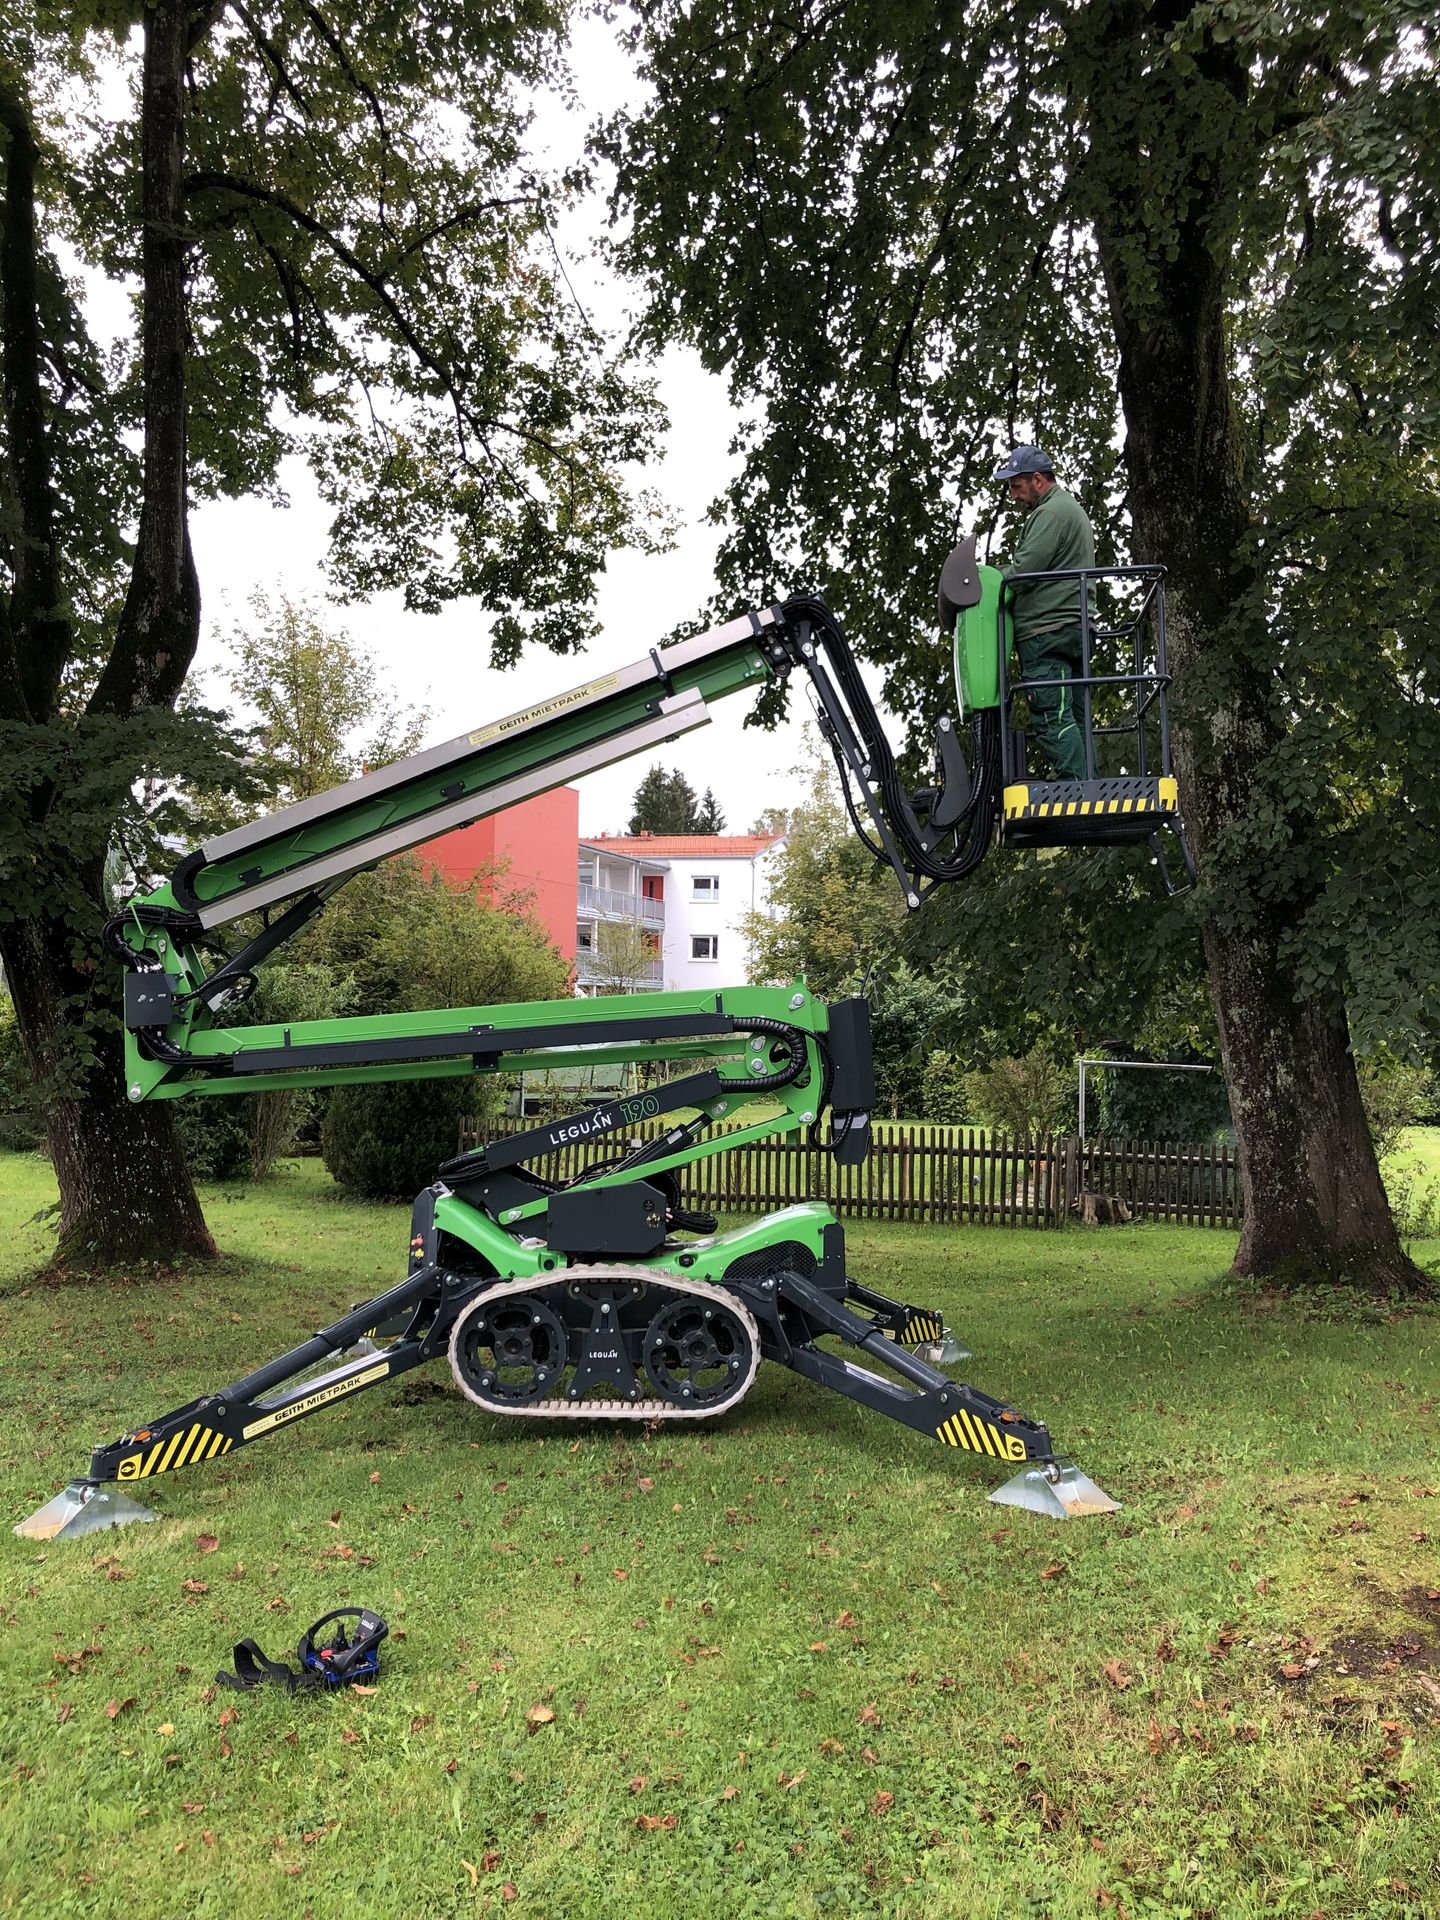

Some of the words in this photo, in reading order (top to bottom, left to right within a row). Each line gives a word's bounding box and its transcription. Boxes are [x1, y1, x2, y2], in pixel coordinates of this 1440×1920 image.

[499, 715, 530, 731] GEITH
[531, 689, 590, 718] MIETPARK
[550, 1108, 613, 1145] LEGUAN
[619, 1095, 660, 1124] 190
[589, 1349, 619, 1358] LEGUAN
[274, 1404, 305, 1422] GEITH
[306, 1377, 361, 1407] MIETPARK
